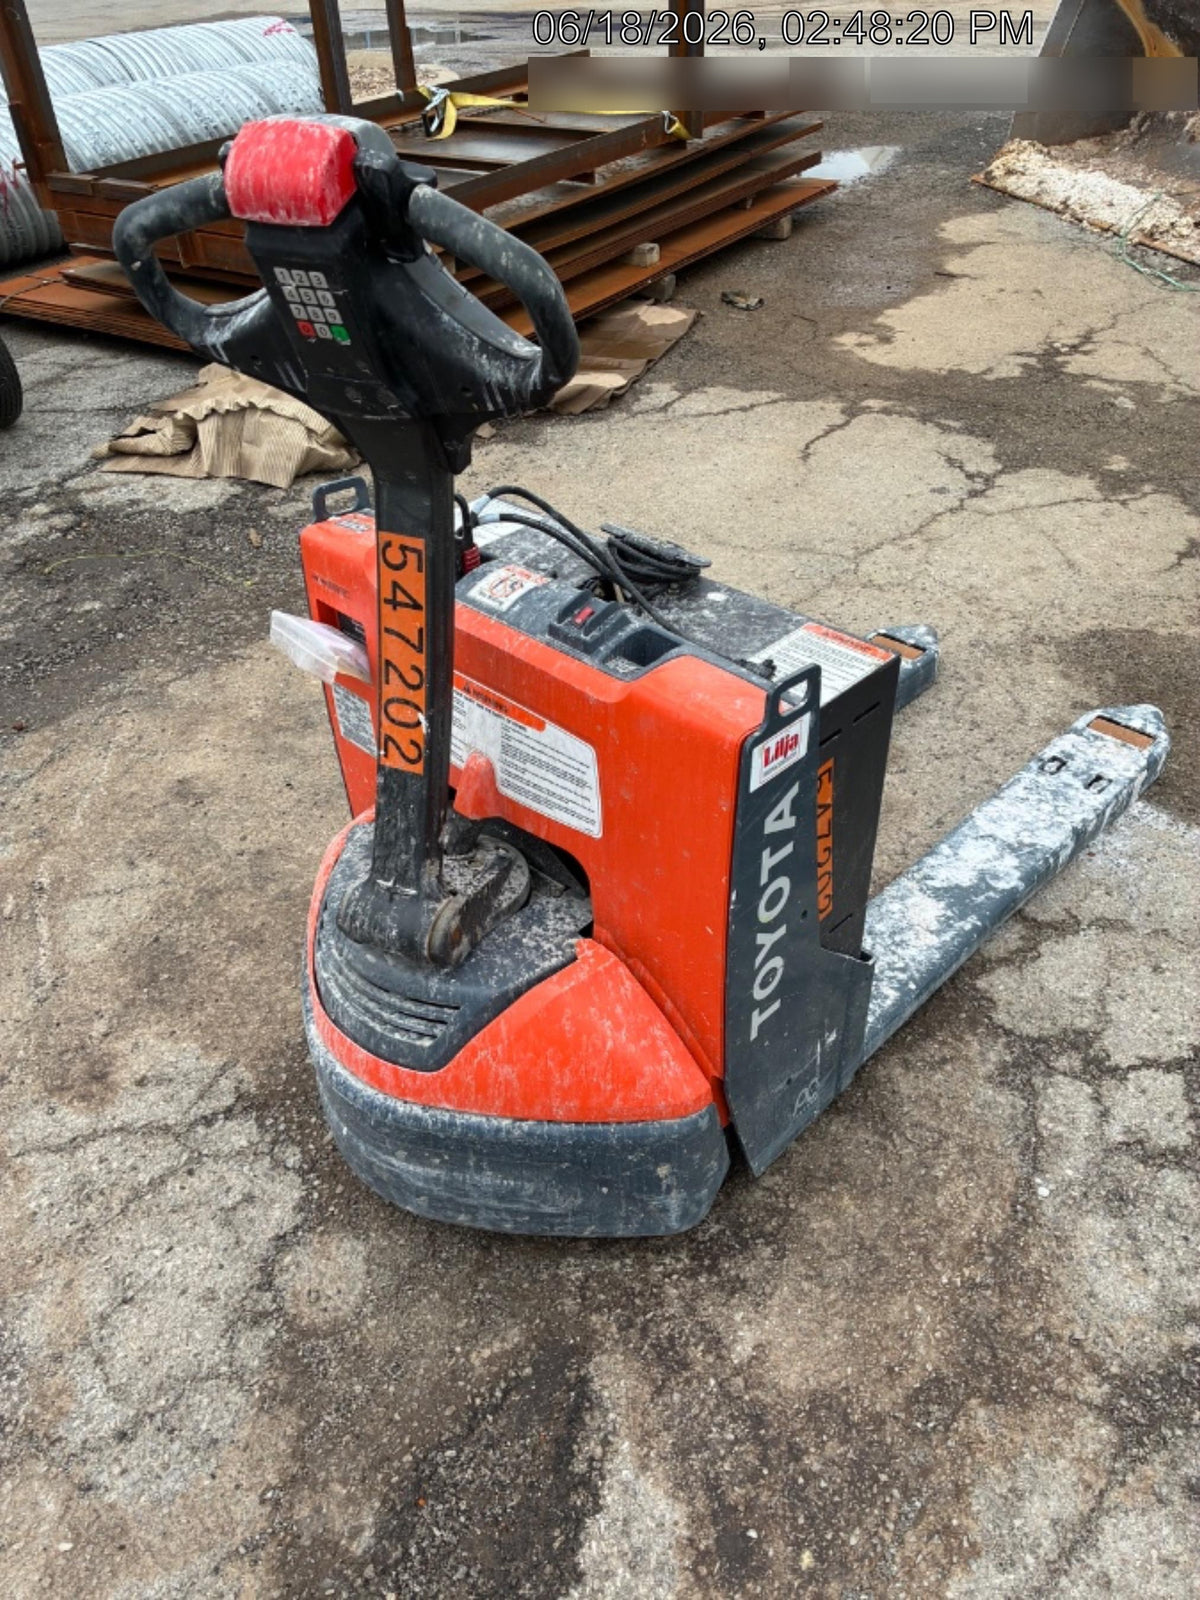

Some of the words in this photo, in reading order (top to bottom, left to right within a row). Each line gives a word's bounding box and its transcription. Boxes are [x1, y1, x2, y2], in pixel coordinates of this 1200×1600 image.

[382, 540, 424, 765] 547202
[763, 733, 799, 768] Lilja
[749, 781, 800, 1042] TOYOTA
